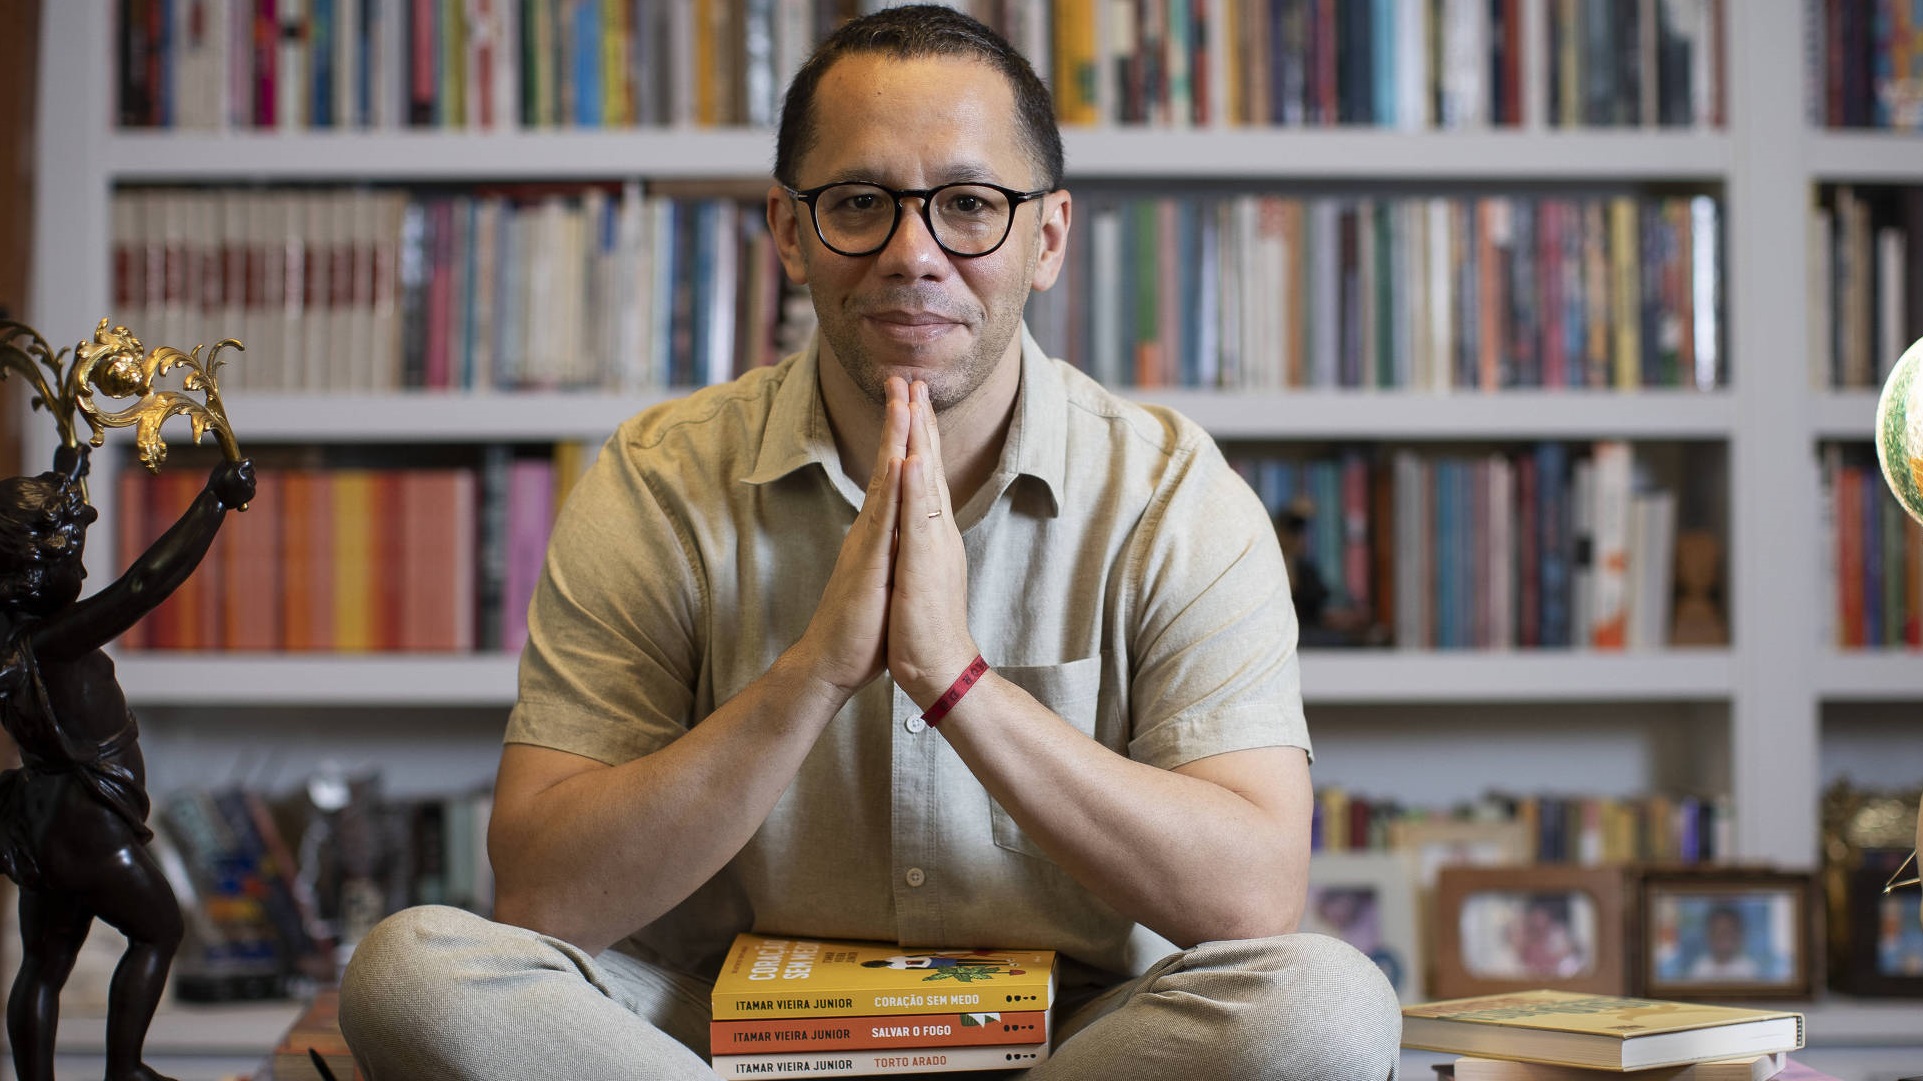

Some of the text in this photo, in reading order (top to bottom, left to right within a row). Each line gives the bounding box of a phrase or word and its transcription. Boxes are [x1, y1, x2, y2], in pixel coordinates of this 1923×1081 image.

[782, 941, 819, 979] SEM MED
[736, 998, 853, 1011] ITAMAR VIEIRA JUNIOR
[874, 994, 980, 1008] CORAÇÃO SEM MEDO
[733, 1029, 850, 1042] ITAMAR VIEIRA JUNIOR
[871, 1025, 952, 1038] SALVAR O FOGO
[736, 1059, 853, 1073] ITAMAR VIEIRA JUNIOR
[874, 1055, 947, 1068] TORTO ARADO
